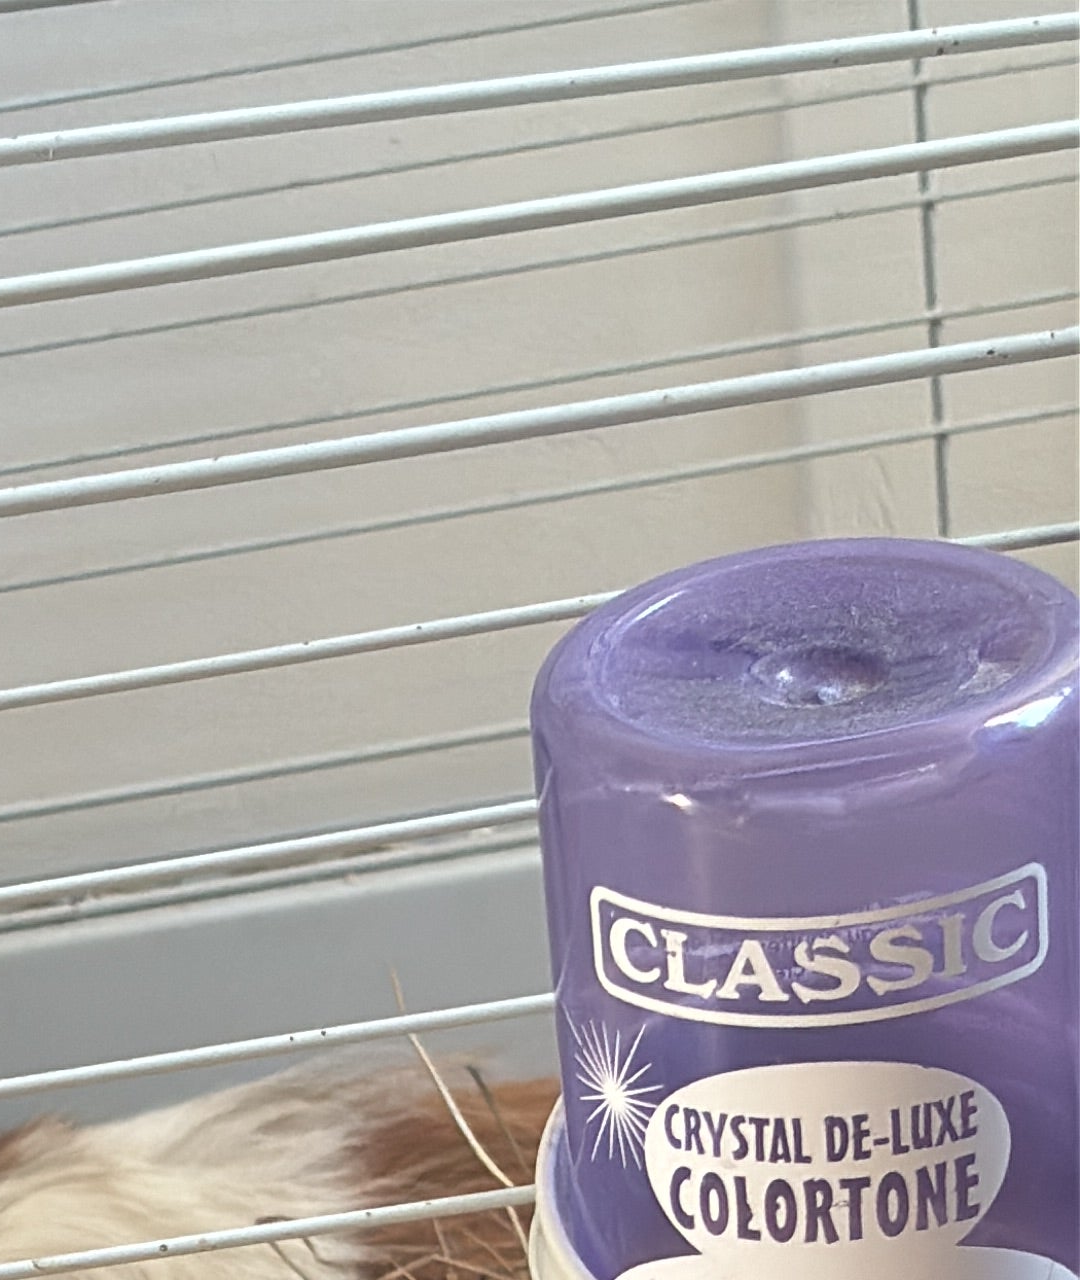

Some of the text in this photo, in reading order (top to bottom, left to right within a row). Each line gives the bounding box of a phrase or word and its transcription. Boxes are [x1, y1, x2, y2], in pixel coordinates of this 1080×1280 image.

[609, 890, 1027, 1003] CLASSIC
[664, 1090, 978, 1164] CRYSTAL DE-LUXE
[670, 1153, 982, 1245] COLORTONE
